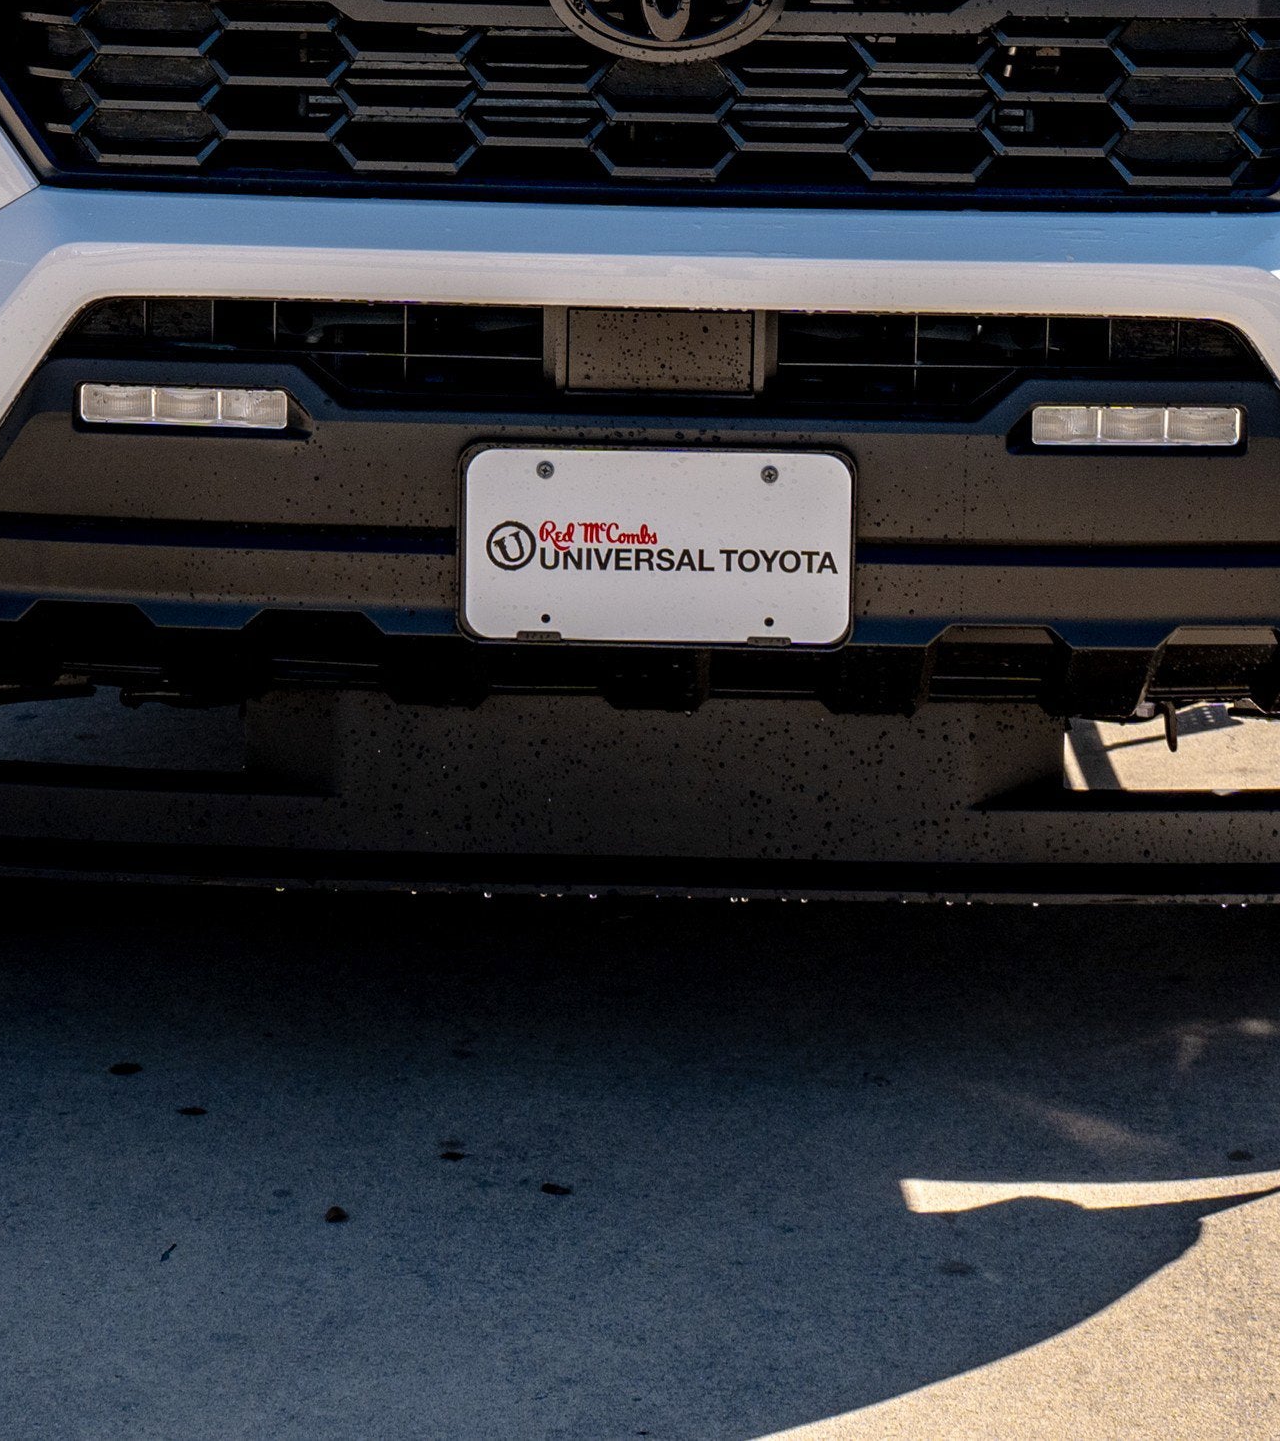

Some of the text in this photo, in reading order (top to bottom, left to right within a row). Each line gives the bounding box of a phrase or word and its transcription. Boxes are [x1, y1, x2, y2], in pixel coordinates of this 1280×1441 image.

[538, 520, 658, 551] Red McCombs
[539, 547, 839, 574] UNIVERSAL TOYOTA
